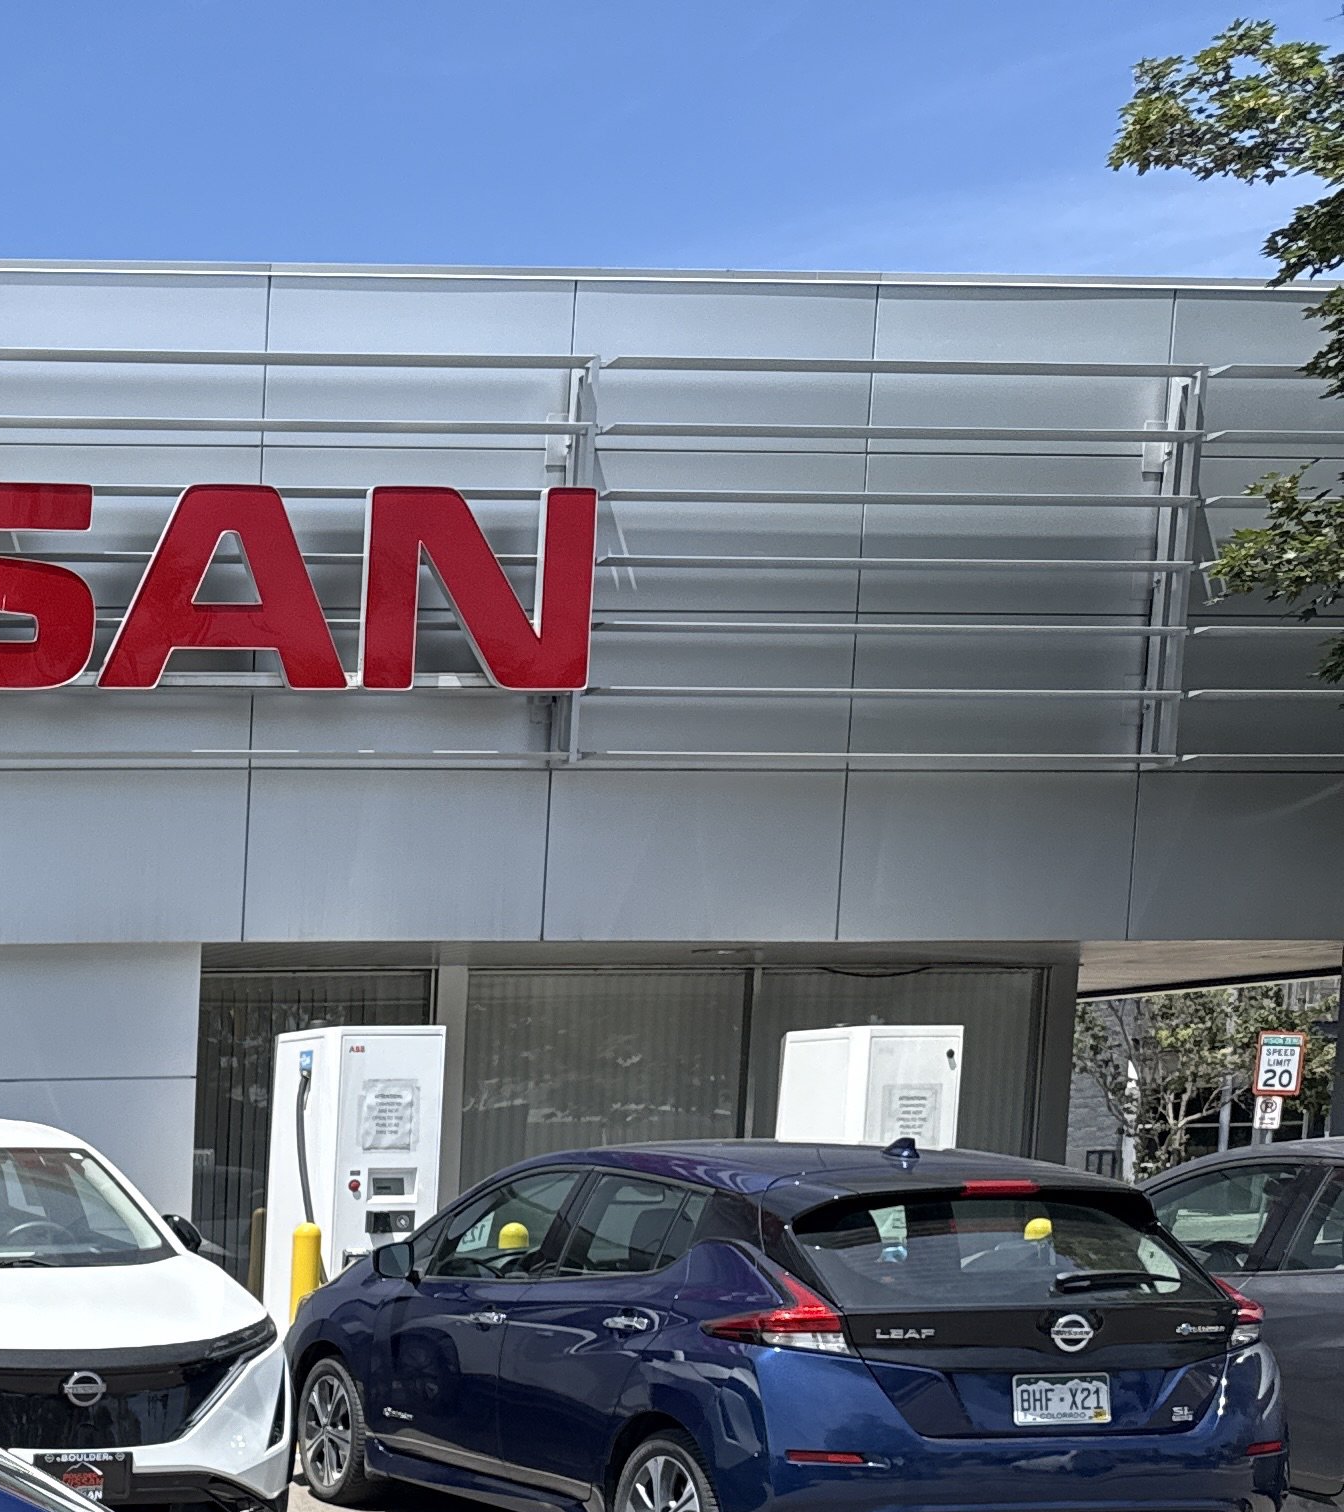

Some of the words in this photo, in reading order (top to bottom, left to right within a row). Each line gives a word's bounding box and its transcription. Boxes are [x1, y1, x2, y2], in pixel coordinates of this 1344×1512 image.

[1266, 1048, 1296, 1056] SPEED
[1267, 1059, 1291, 1067] LIMIT
[1262, 1069, 1292, 1088] 20
[876, 1328, 935, 1339] LEAF
[1040, 1411, 1086, 1420] COLORADO
